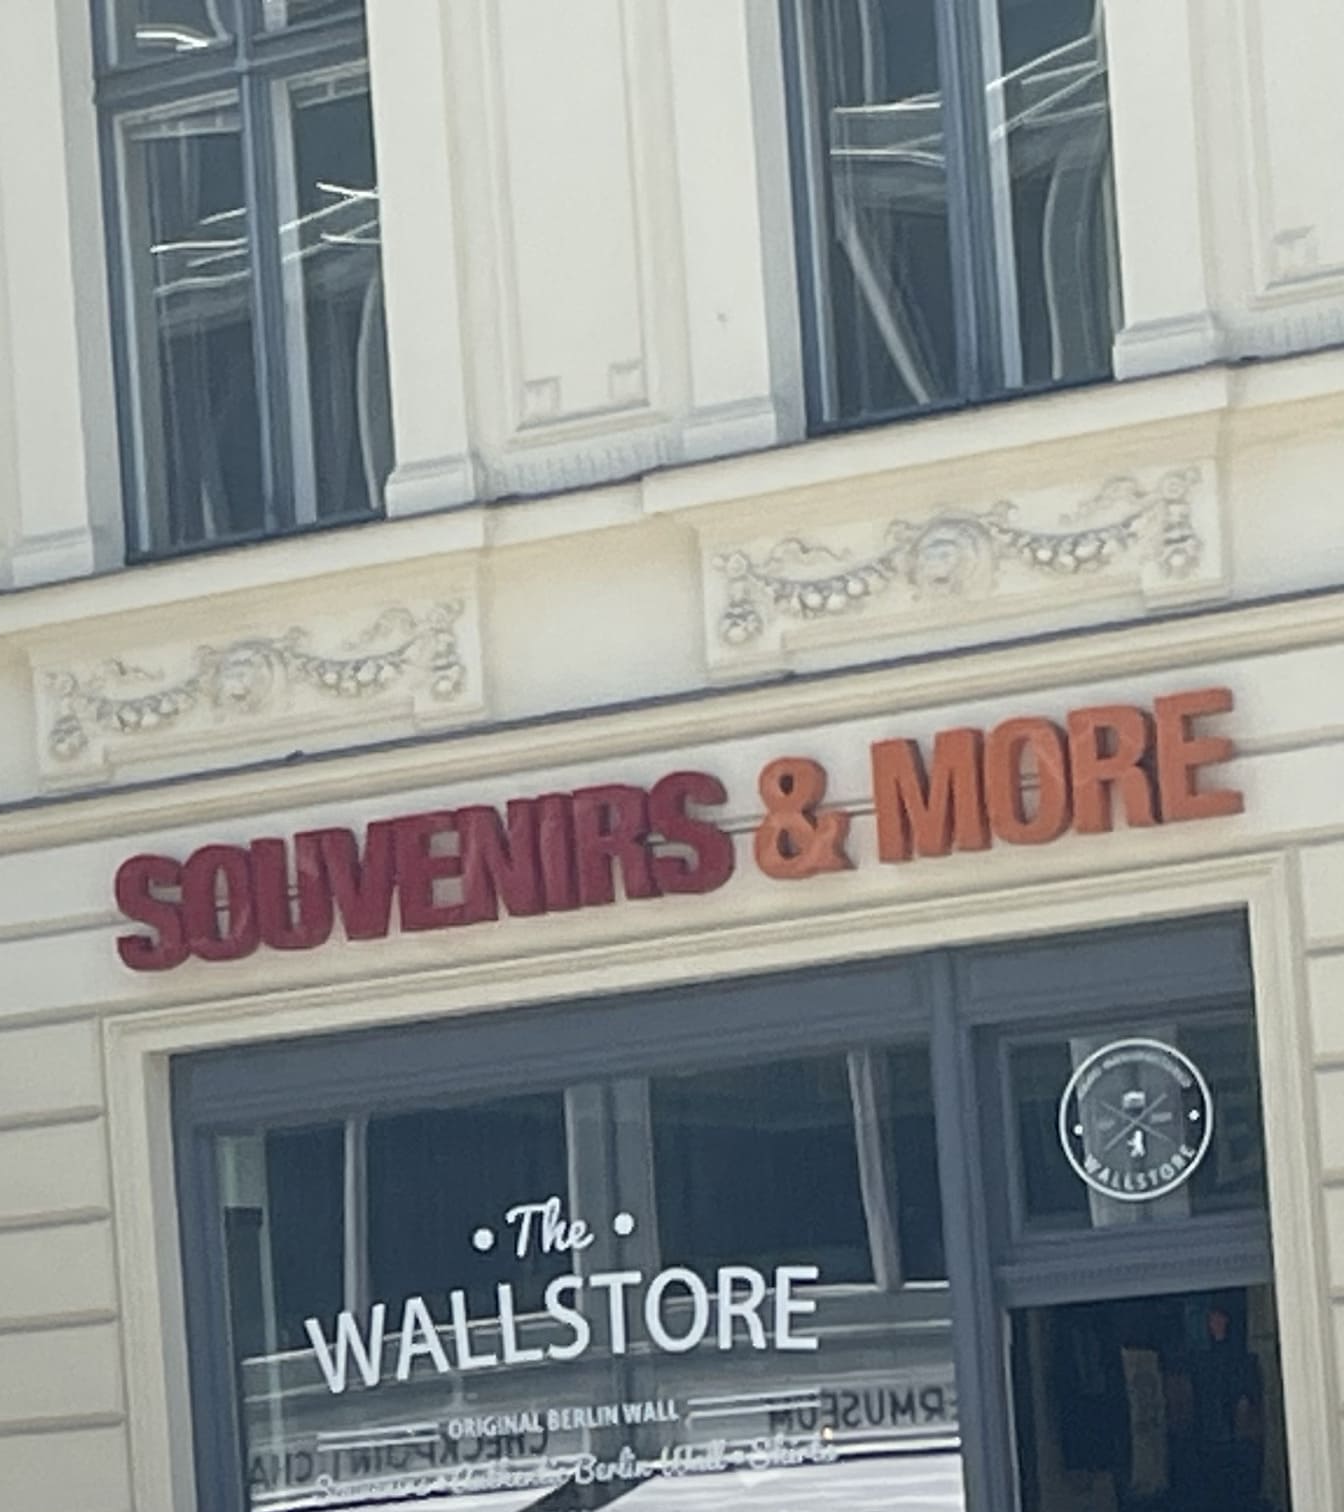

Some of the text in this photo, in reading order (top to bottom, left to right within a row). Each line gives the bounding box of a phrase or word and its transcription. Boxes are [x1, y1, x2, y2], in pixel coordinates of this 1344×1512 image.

[113, 686, 1246, 970] SOUVENIRS & MORE
[1083, 1144, 1196, 1192] WALLSTORE
[504, 1195, 596, 1260] The
[304, 1265, 821, 1395] WALLSTORE
[447, 1397, 679, 1441] ORIGINAL BERLIN WALL
